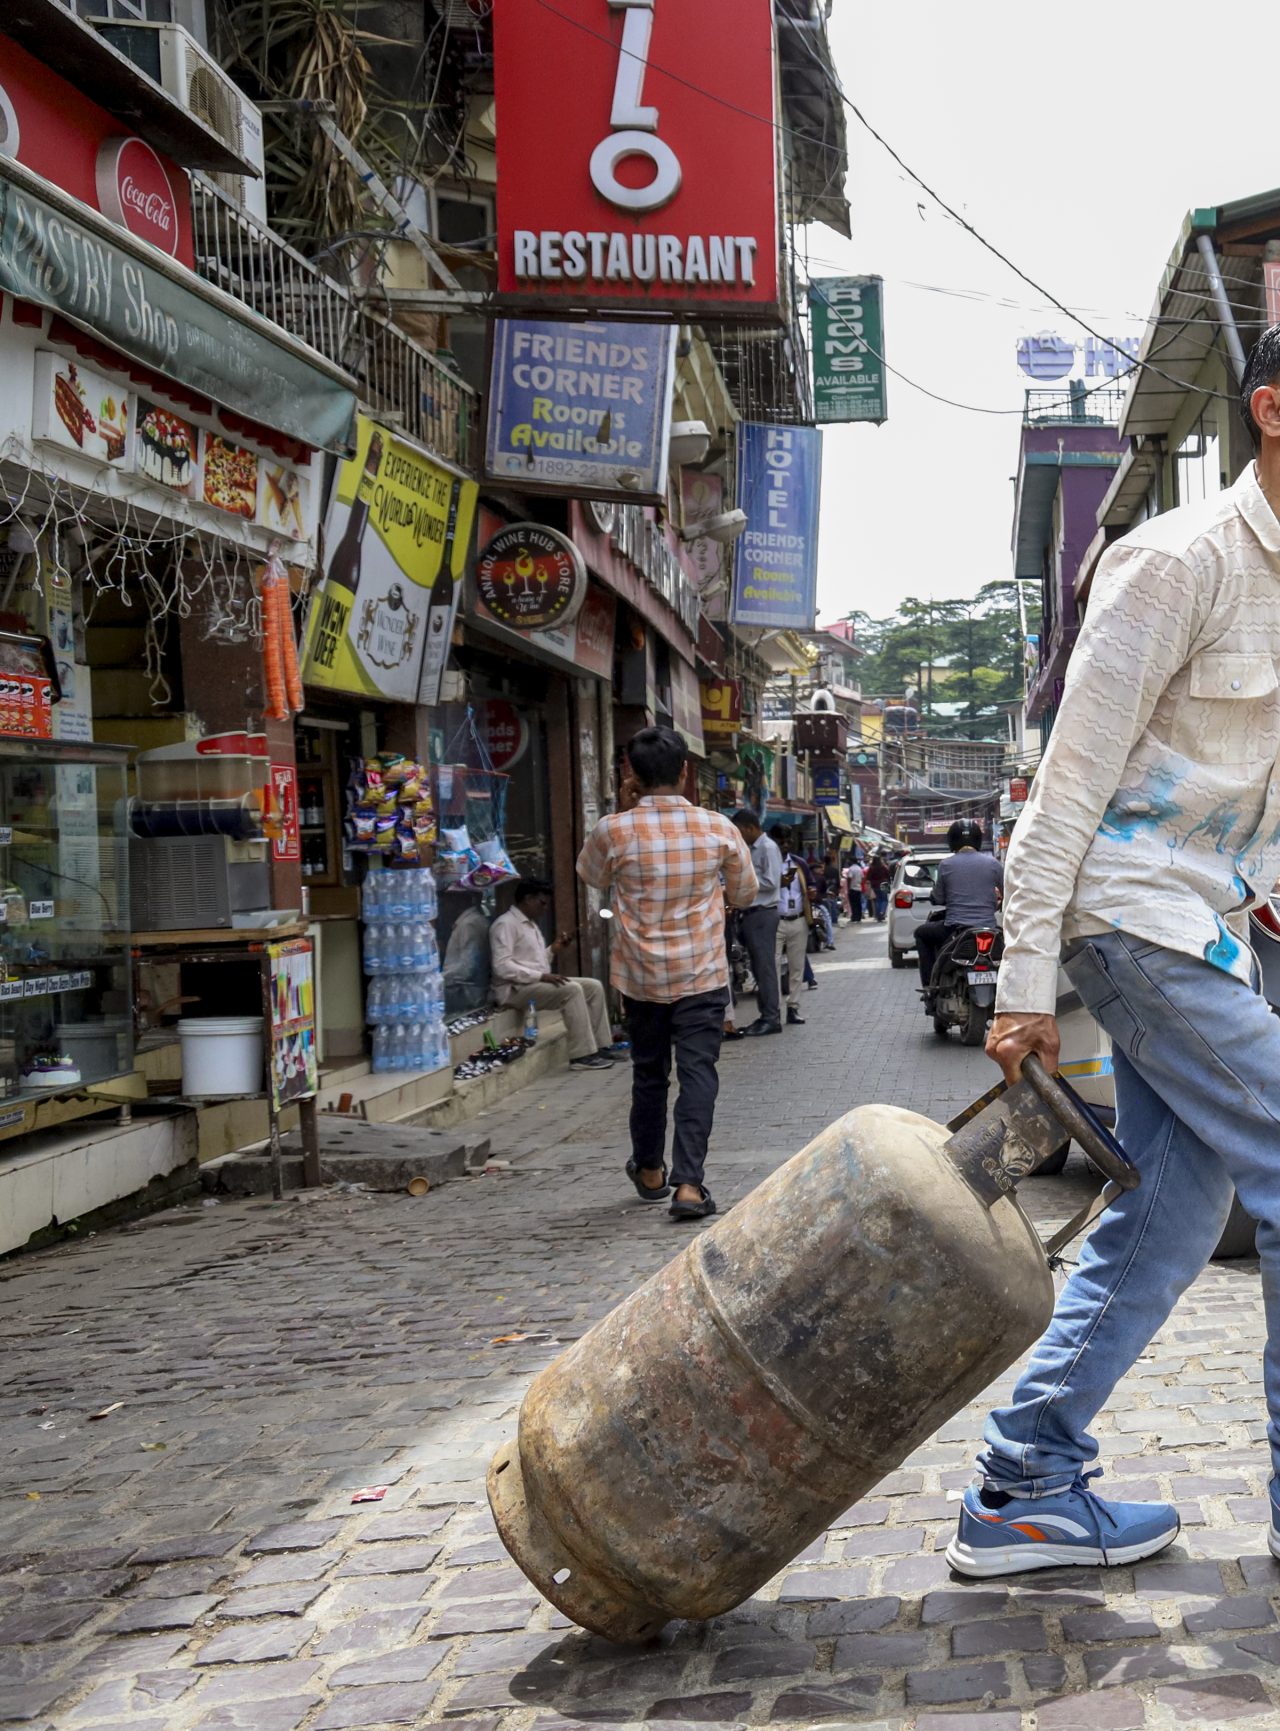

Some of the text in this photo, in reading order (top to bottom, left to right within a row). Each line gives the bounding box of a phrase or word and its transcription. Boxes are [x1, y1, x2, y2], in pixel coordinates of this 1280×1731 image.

[121, 176, 171, 232] Coca-Cola
[12, 194, 179, 366] PASTRY Shop
[513, 229, 758, 288] RESTAURANT
[512, 330, 649, 372] FRIENDS
[824, 287, 869, 372] ROOMS
[512, 363, 645, 406] CORNER
[816, 373, 880, 387] AVAILABLE
[383, 451, 449, 508] EXPERIENCE THE
[765, 429, 793, 529] HOTEL
[374, 484, 446, 549] WORLD WONDER
[744, 530, 805, 550] FRIENDS
[480, 530, 570, 600] ANMOL WINE HUB STORE
[744, 548, 804, 568] CORNER
